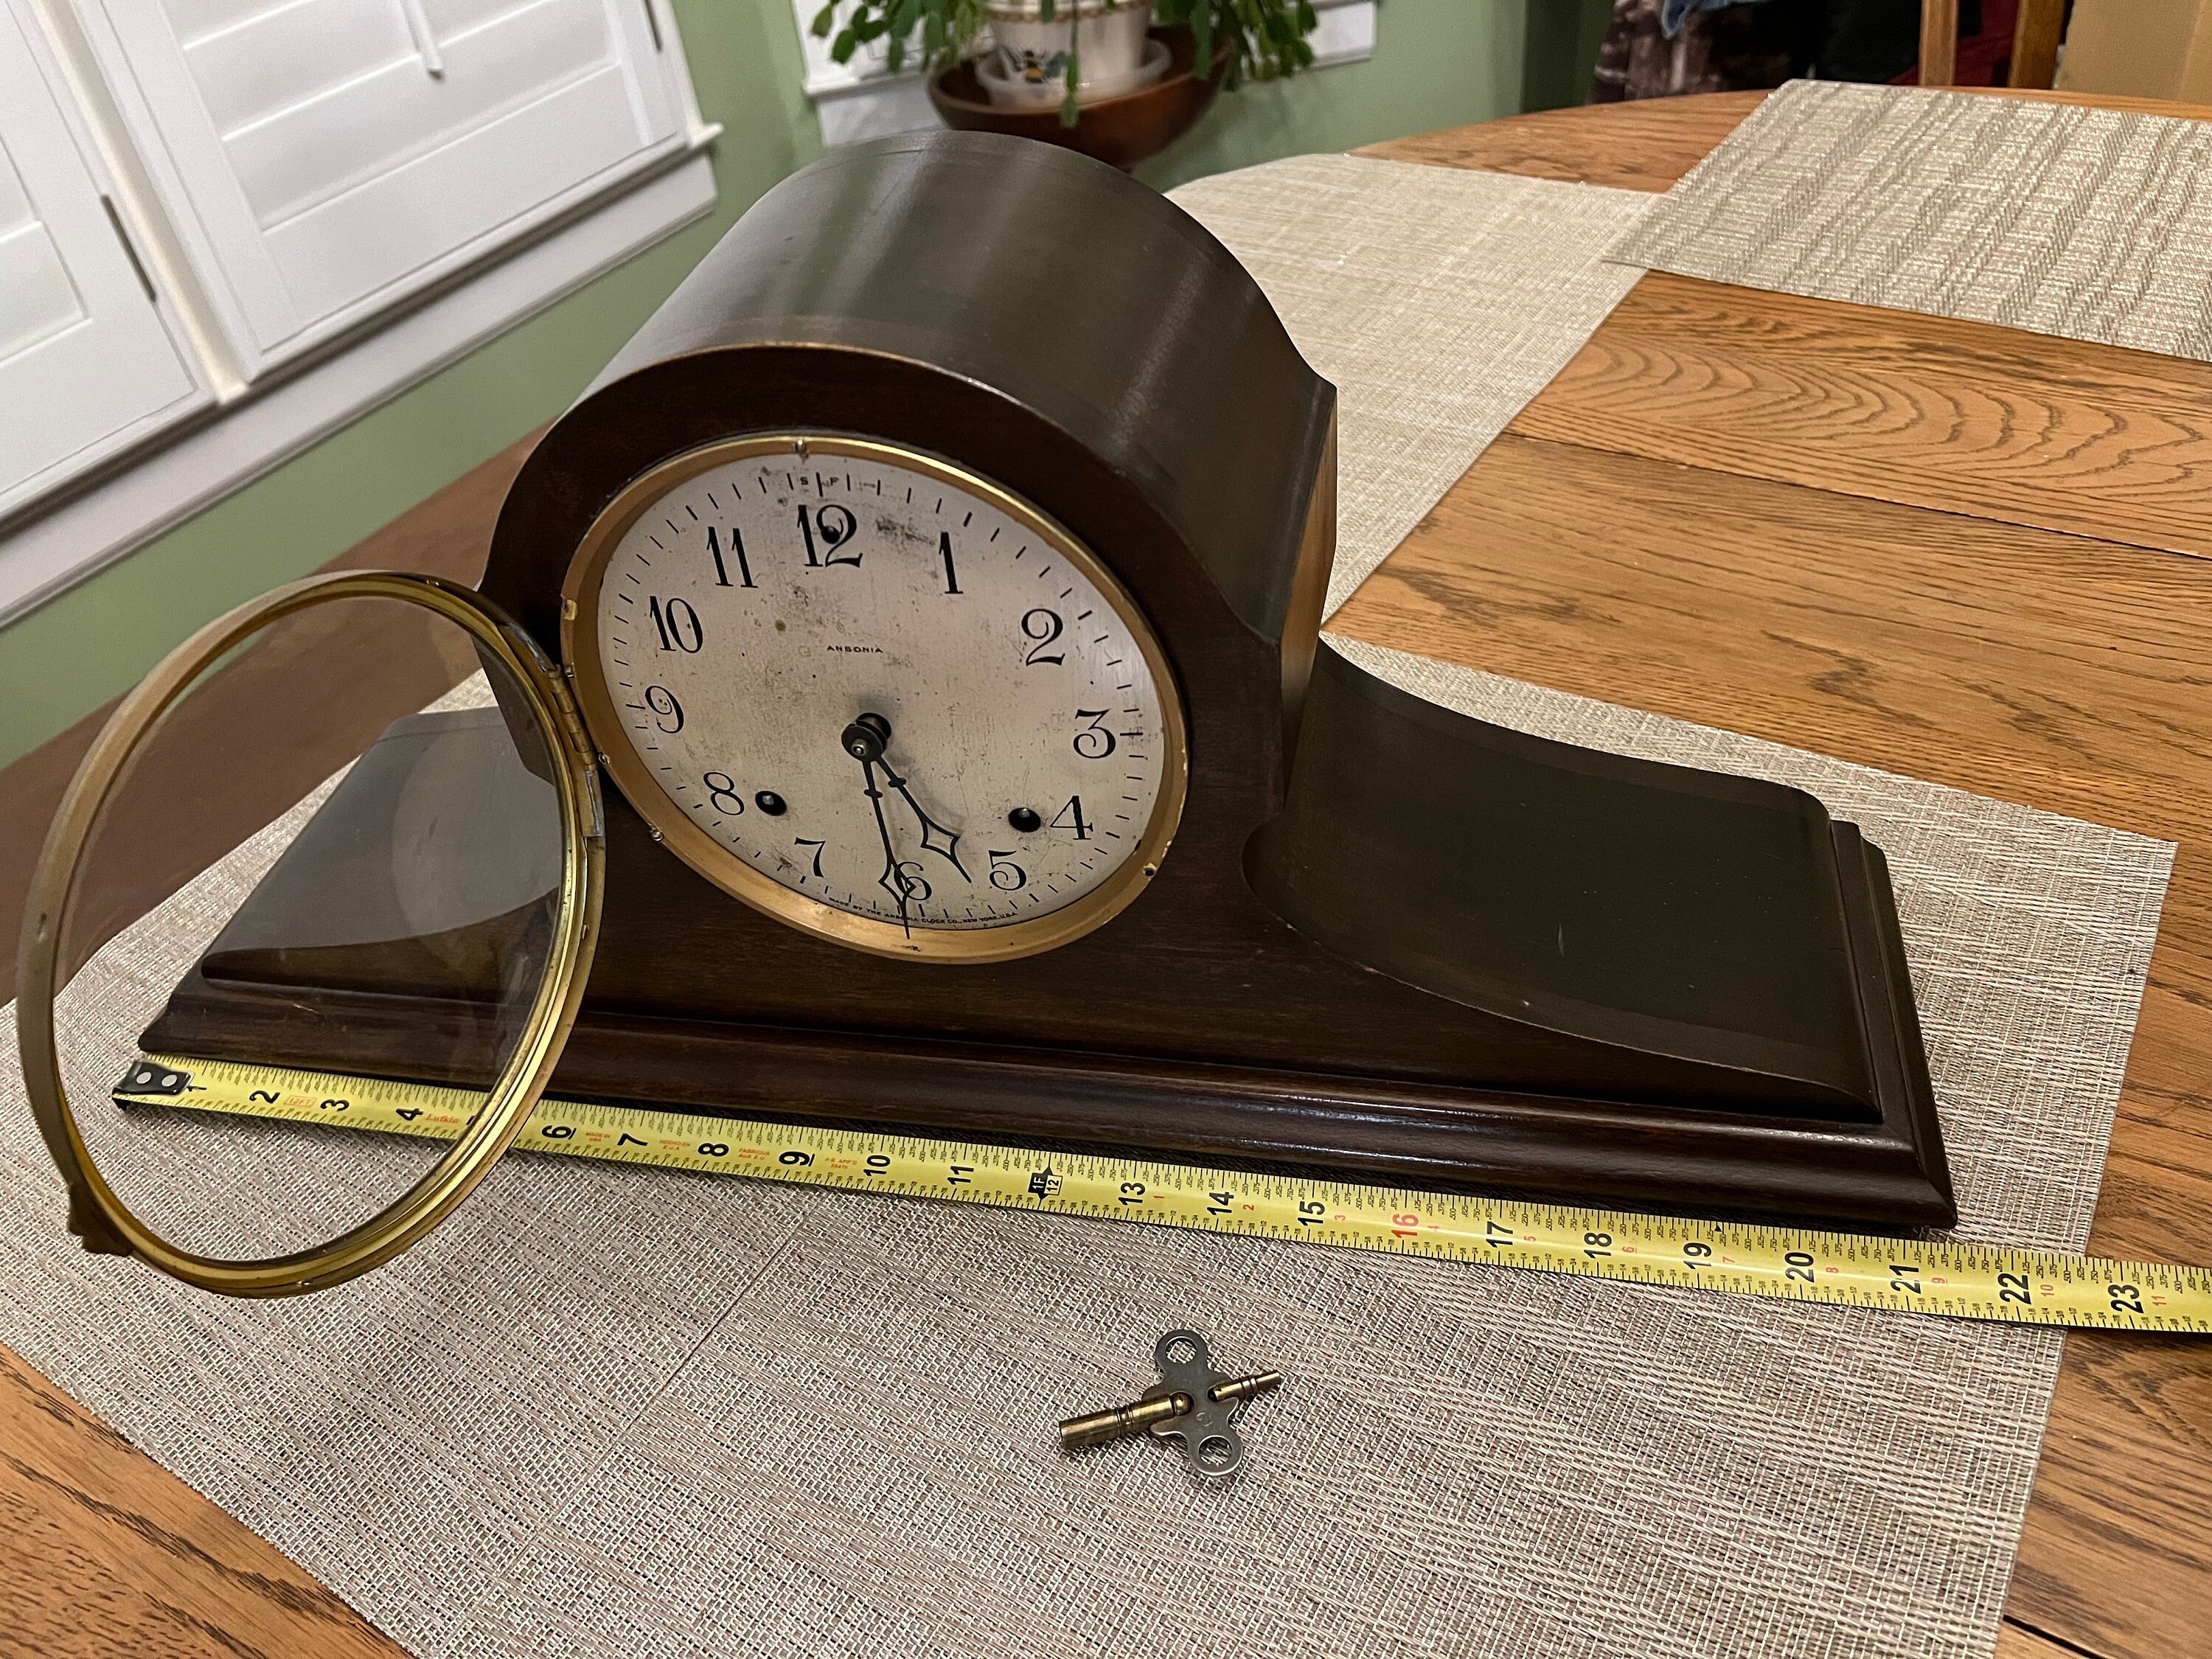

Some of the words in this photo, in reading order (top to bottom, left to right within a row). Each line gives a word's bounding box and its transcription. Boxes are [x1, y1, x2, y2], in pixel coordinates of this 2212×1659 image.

[797, 504, 863, 568] 12
[707, 526, 758, 588] 11
[939, 532, 964, 594] 1
[649, 596, 703, 654] 10
[1021, 608, 1065, 666] 2
[827, 645, 883, 653] ANSONIA
[645, 686, 684, 734] 9
[1073, 709, 1116, 759] 3
[703, 772, 745, 815] 8
[1049, 796, 1093, 841] 4
[794, 837, 826, 878] 7
[988, 850, 1027, 891] 5
[893, 861, 933, 901] 6
[249, 1091, 280, 1105] 2
[320, 1099, 349, 1112] 3
[395, 1108, 424, 1121] 4
[425, 1113, 460, 1124] Lufkin
[541, 1125, 577, 1140] 6
[617, 1133, 648, 1146] 7
[698, 1142, 729, 1158] 8
[779, 1151, 815, 1166] 9
[863, 1155, 891, 1177] 10
[947, 1165, 975, 1186] 11
[1047, 1178, 1060, 1194] 12
[1118, 1182, 1146, 1207] 13
[1207, 1192, 1235, 1217] 14
[1243, 1203, 1254, 1211] 2
[1298, 1201, 1326, 1227] 15
[1391, 1213, 1419, 1239] 16
[1486, 1221, 1514, 1249] 17
[1584, 1233, 1613, 1259] 18
[1622, 1245, 1637, 1254] 6
[1683, 1242, 1713, 1270] 19
[1784, 1252, 1815, 1283] 20
[1889, 1262, 1922, 1295] 21
[1998, 1273, 2031, 1304] 22
[2041, 1283, 2054, 1298] 10
[2110, 1284, 2145, 1315] 23
[2152, 1295, 2167, 1307] 11
